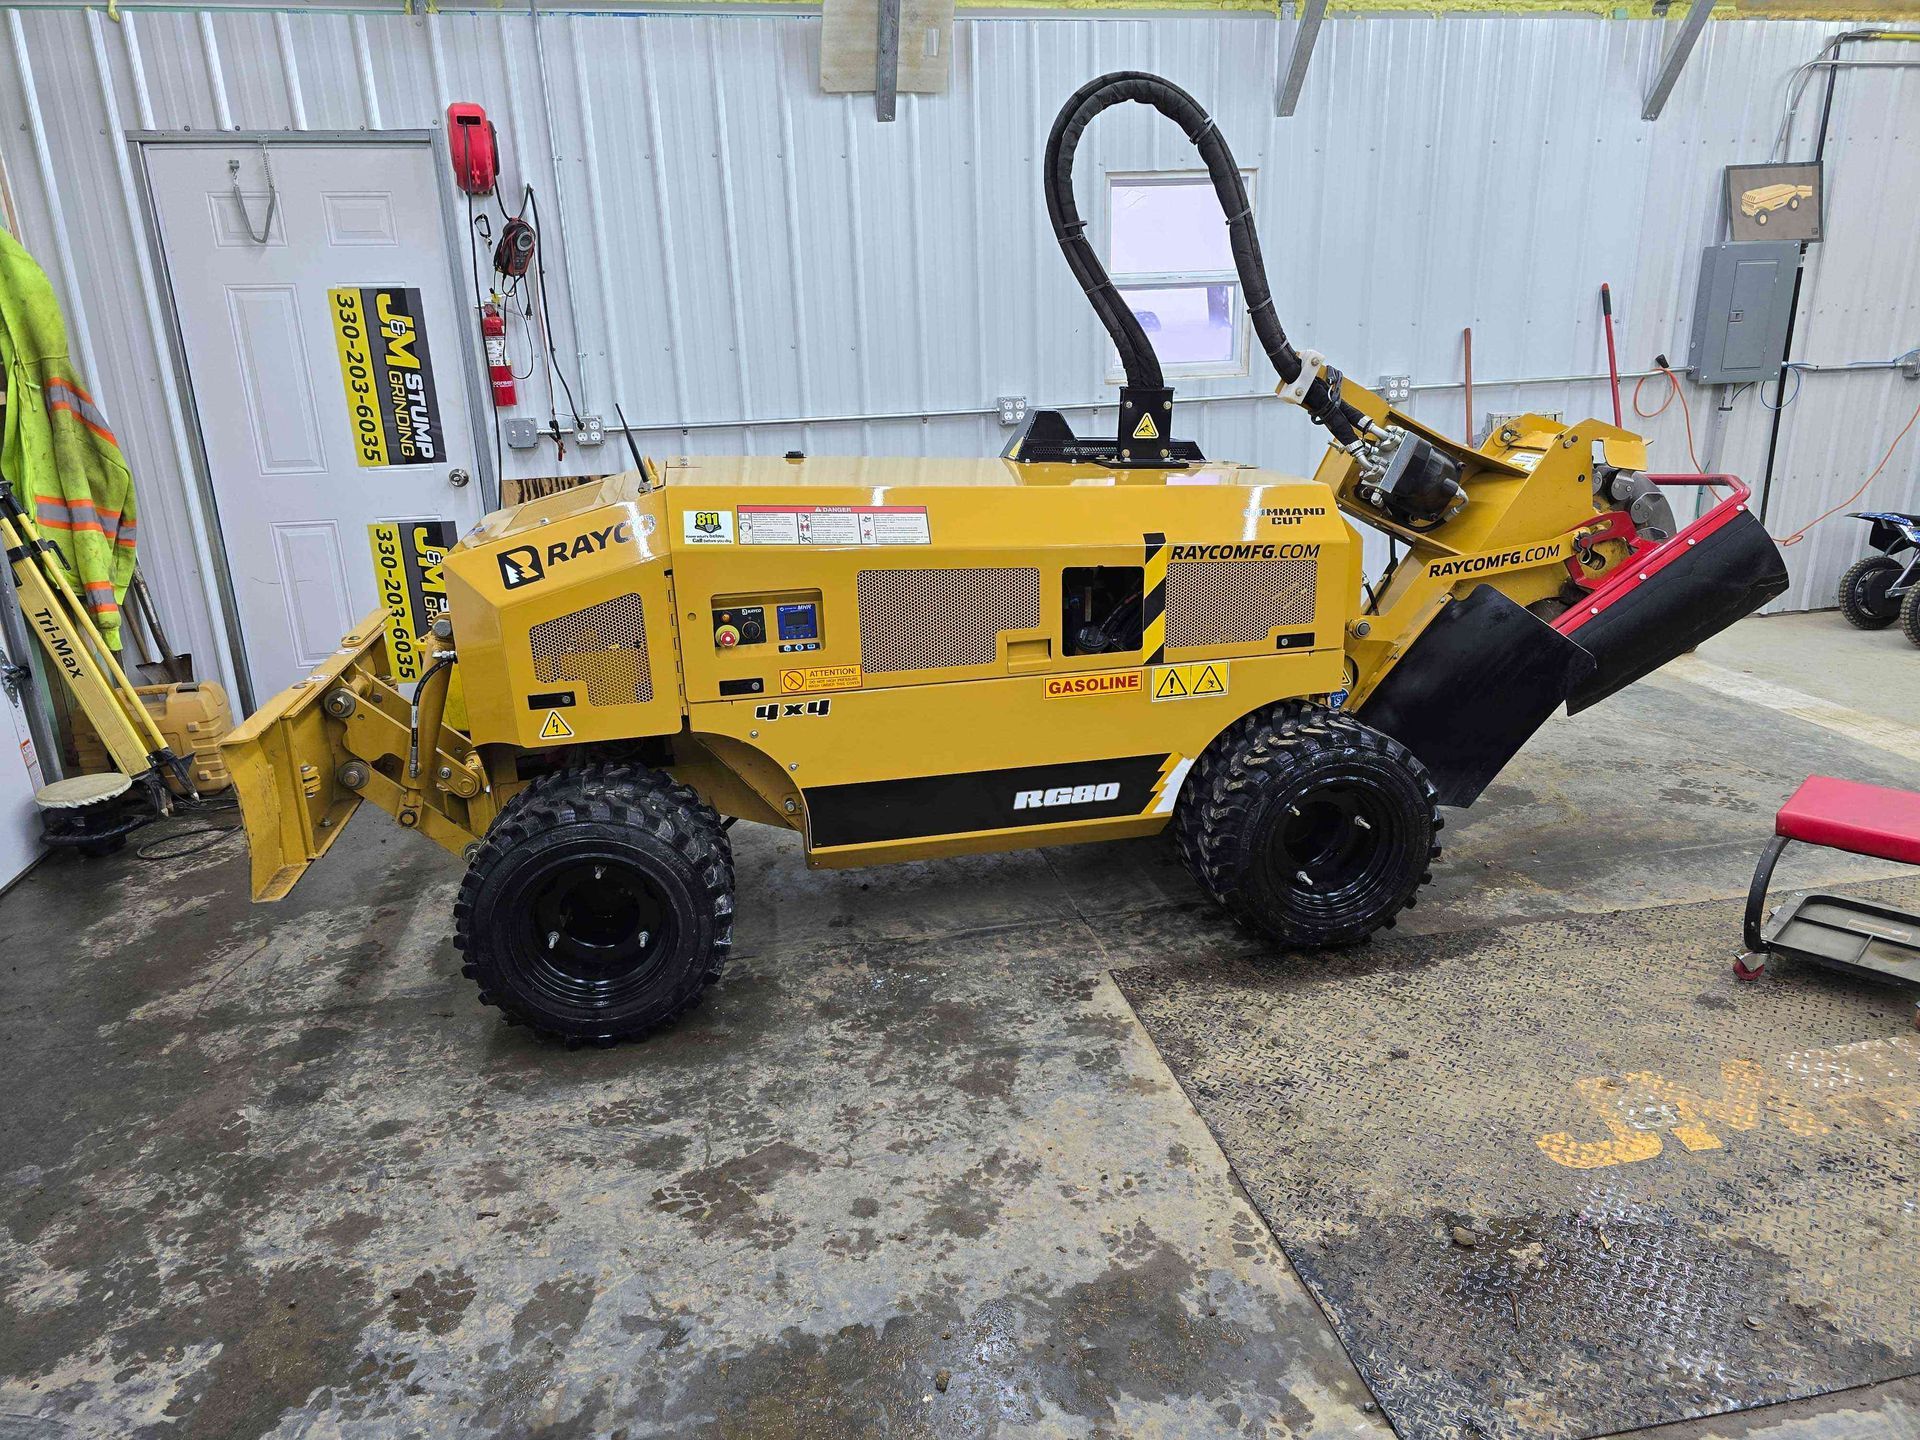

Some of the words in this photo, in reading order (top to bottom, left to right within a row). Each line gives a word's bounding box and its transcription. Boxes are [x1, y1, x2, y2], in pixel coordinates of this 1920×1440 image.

[375, 293, 421, 369] J&M
[336, 294, 382, 462] 330-203-6035
[388, 370, 415, 457] GRINDING
[405, 373, 435, 459] STUMP
[696, 512, 718, 526] 811
[1272, 516, 1304, 524] CUT
[1171, 544, 1320, 560] RAYCOMFG.COM
[1428, 544, 1560, 578] RAYCOMFG.COM
[376, 528, 416, 679] 330-203-6035
[34, 608, 84, 679] Tri-Max
[1048, 675, 1138, 694] GASOLINE
[755, 699, 830, 720] 4x4
[1013, 782, 1120, 810] RG80
